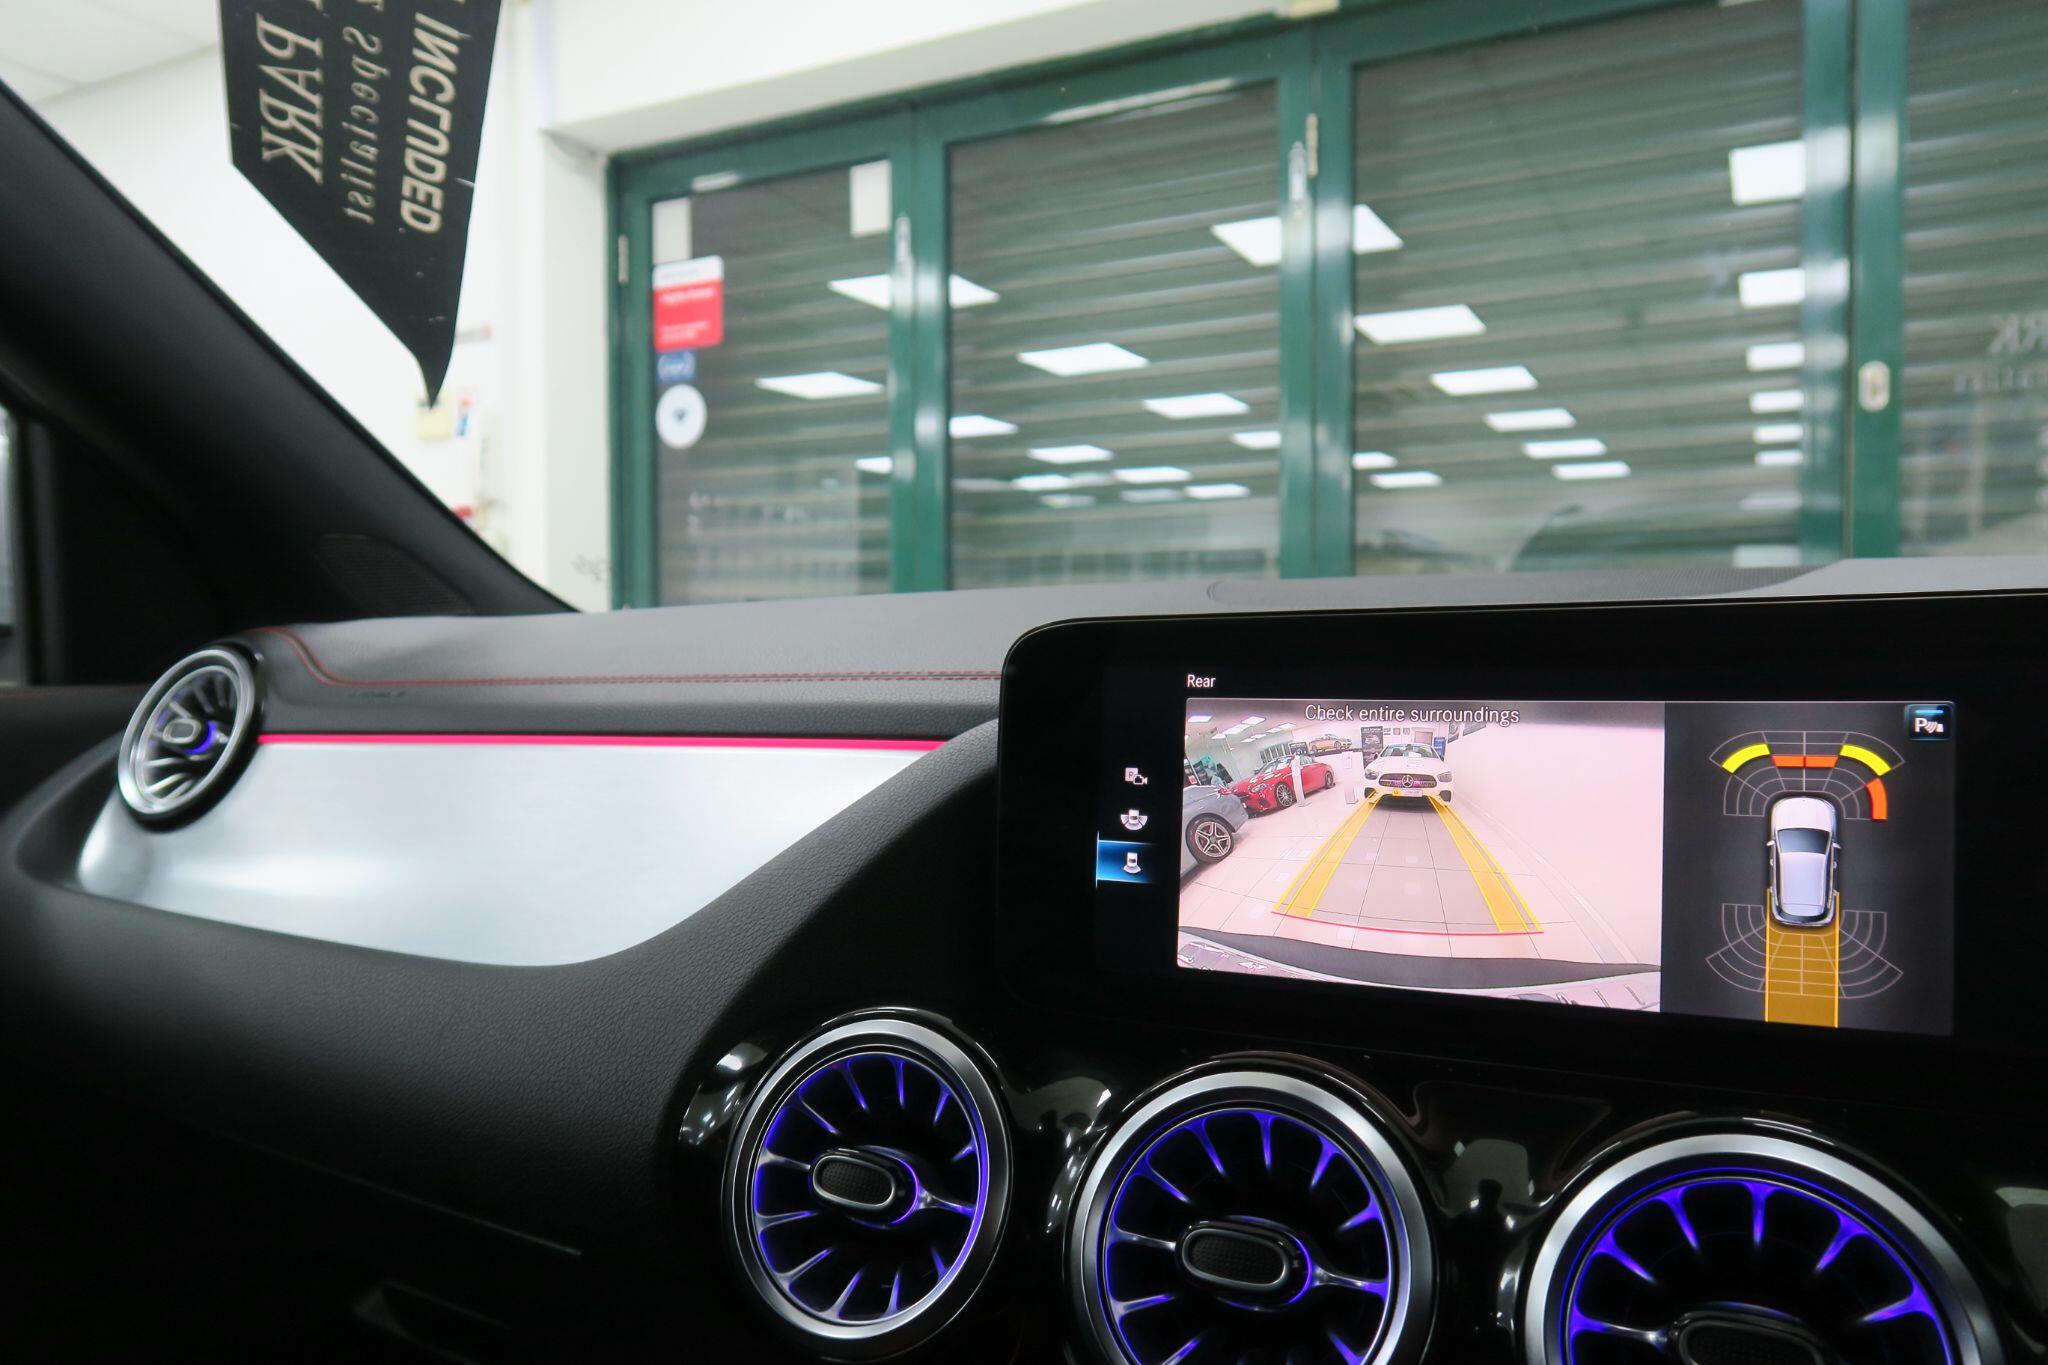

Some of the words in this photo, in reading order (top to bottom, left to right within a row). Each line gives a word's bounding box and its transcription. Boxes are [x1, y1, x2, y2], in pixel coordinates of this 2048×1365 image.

[1187, 674, 1216, 688] Rear
[1305, 704, 1353, 721] Check
[1359, 706, 1405, 722] entire
[1410, 706, 1520, 727] surroundings
